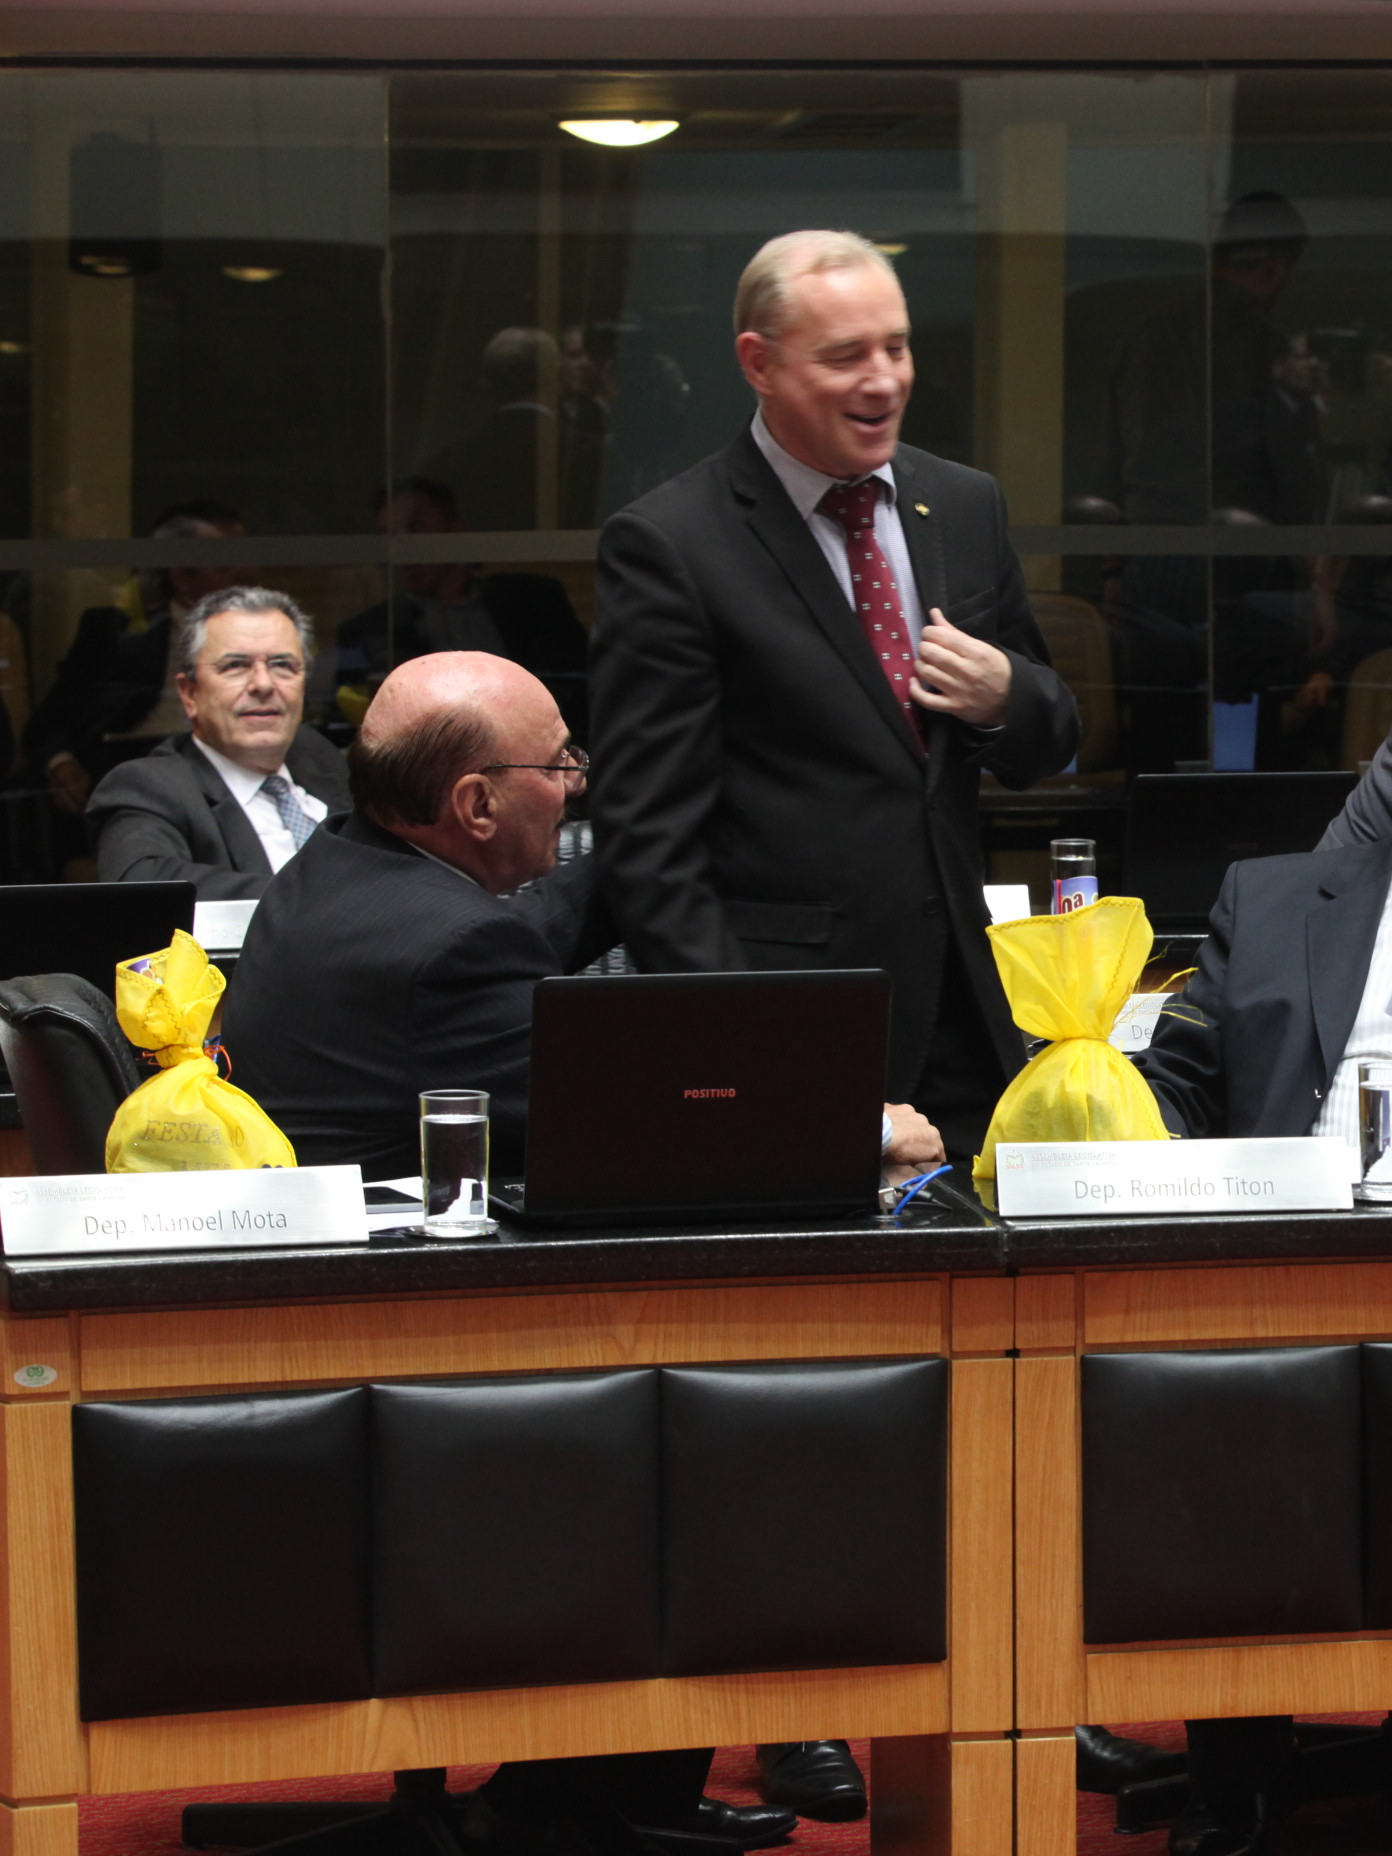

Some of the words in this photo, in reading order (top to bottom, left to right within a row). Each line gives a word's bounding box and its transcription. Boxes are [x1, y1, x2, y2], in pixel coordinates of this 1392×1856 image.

[1131, 1024, 1153, 1040] De
[683, 1088, 736, 1099] POSITIVO
[1074, 1178, 1121, 1203] Dep.
[1130, 1177, 1216, 1199] Romildo
[1222, 1176, 1276, 1197] Titon
[84, 1214, 133, 1240] Dep.
[143, 1209, 224, 1233] Manoel
[231, 1208, 288, 1231] Mota
